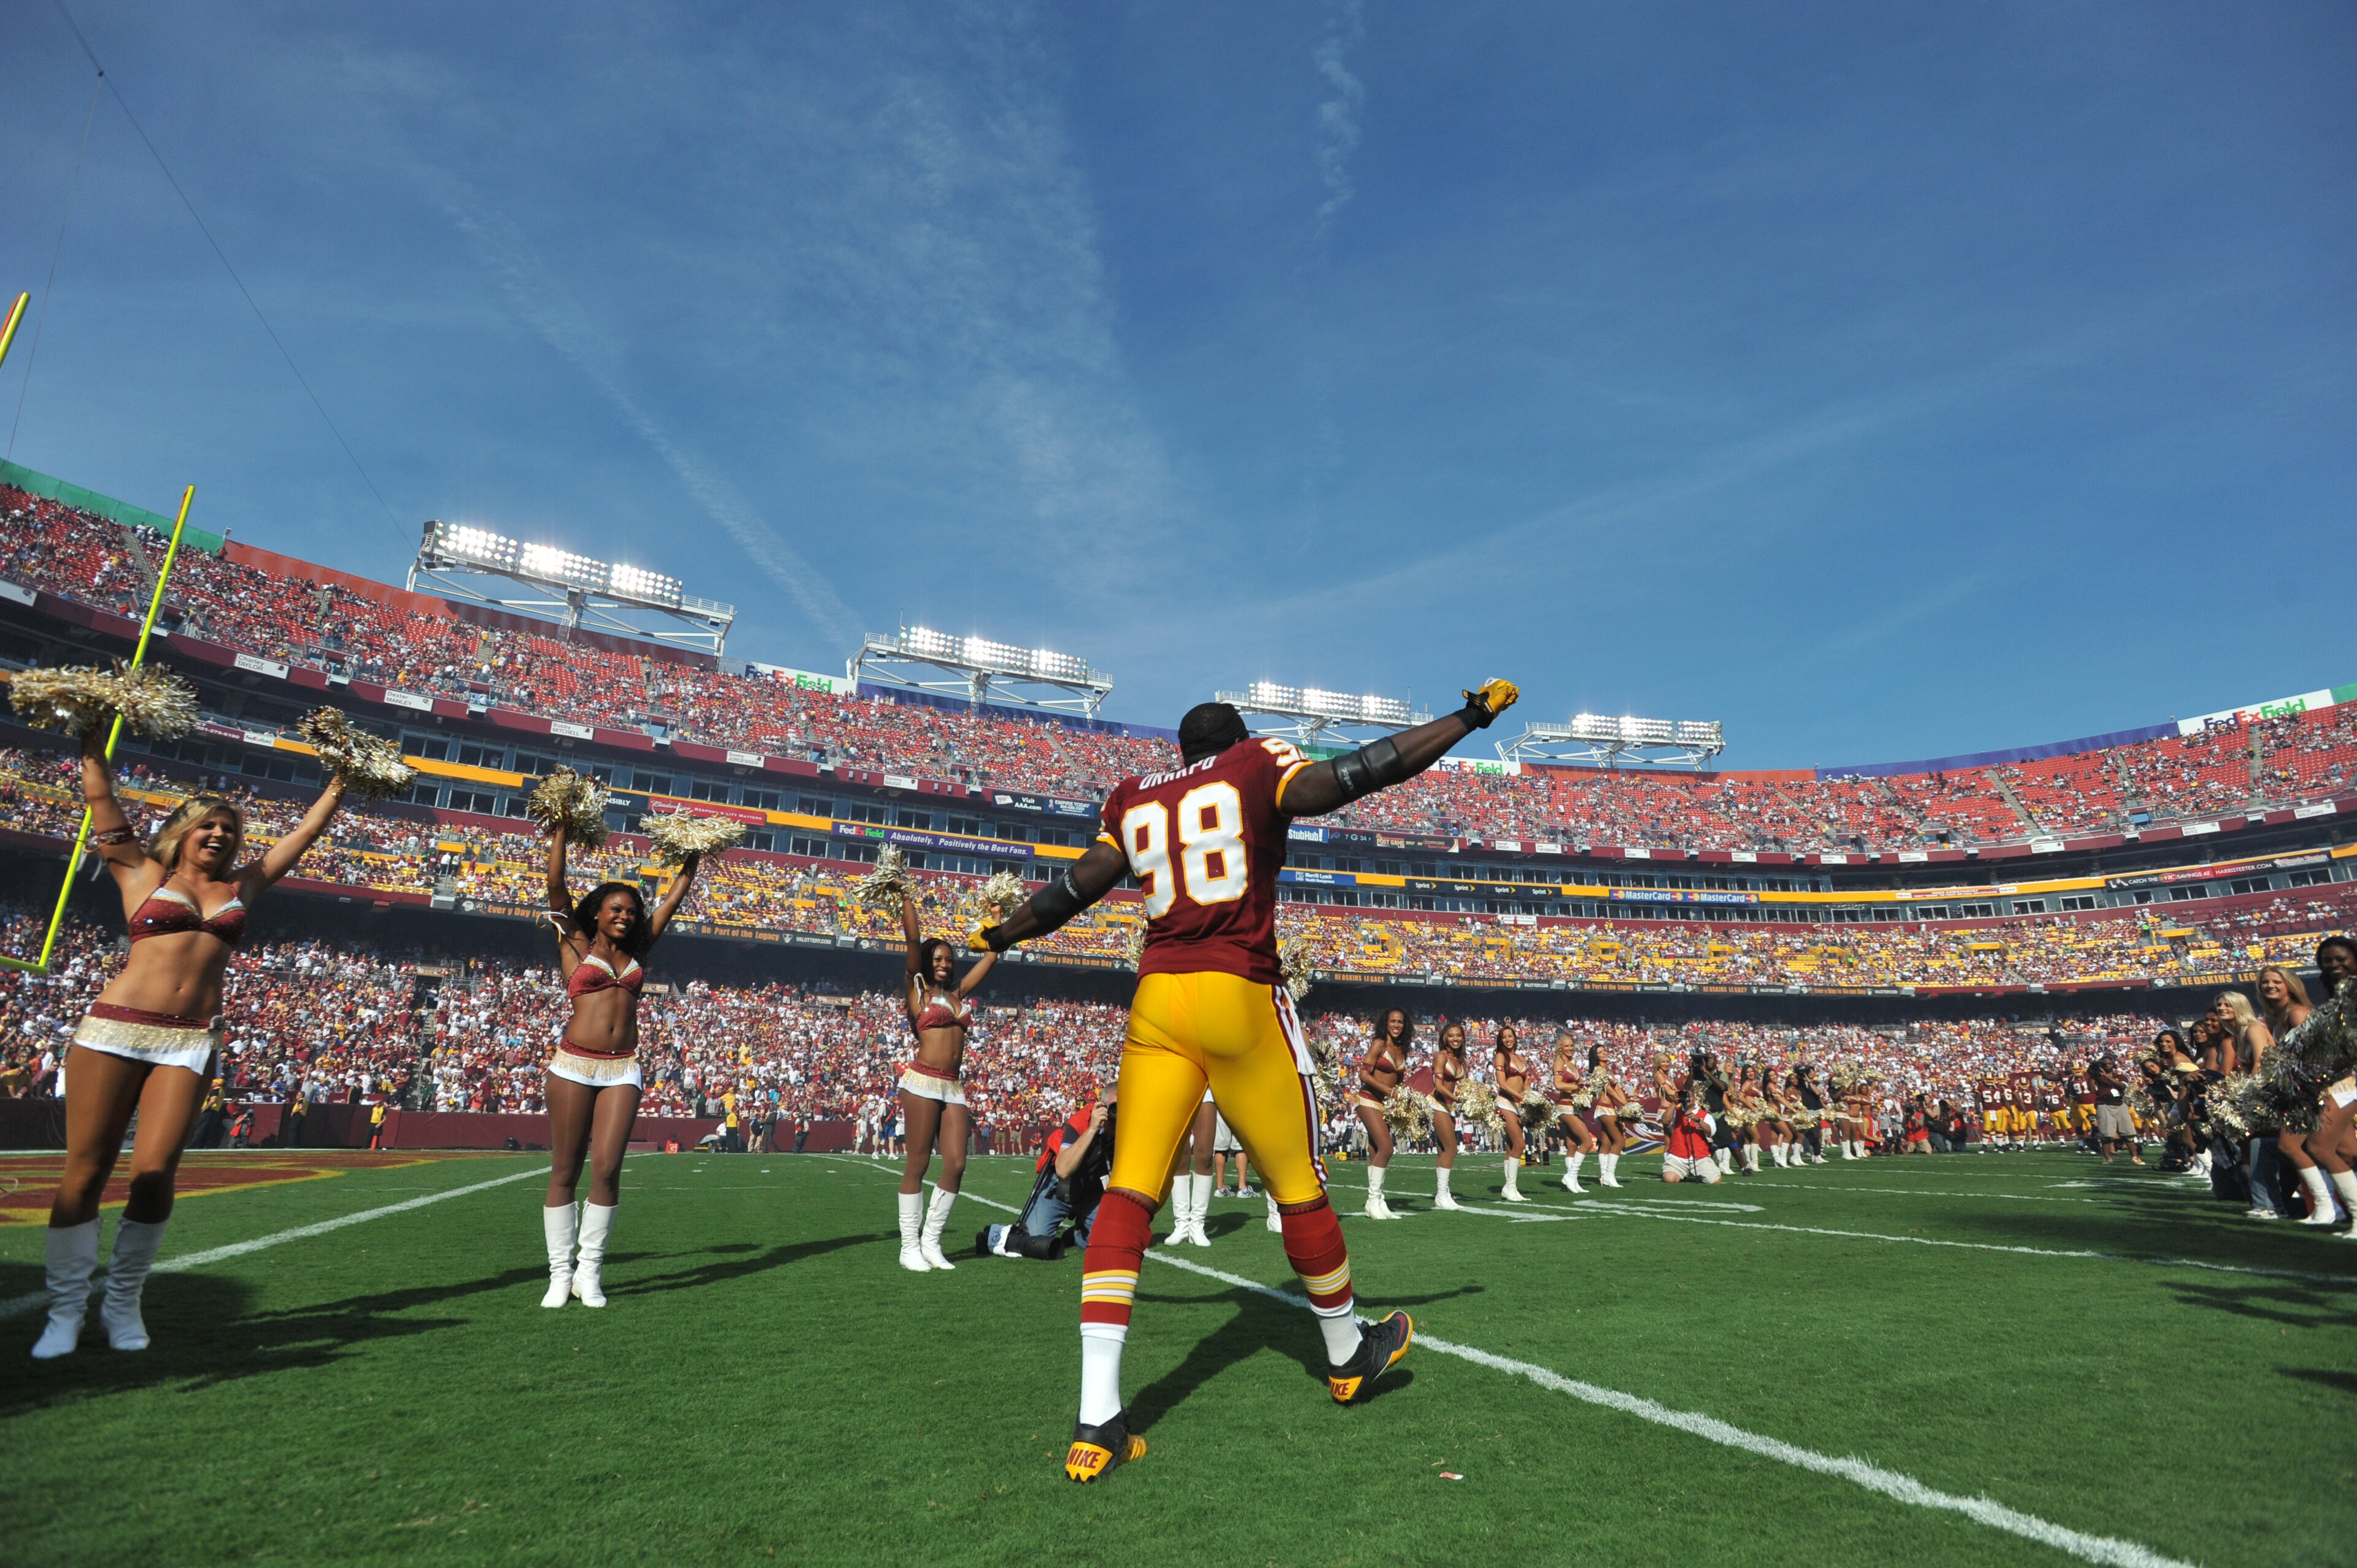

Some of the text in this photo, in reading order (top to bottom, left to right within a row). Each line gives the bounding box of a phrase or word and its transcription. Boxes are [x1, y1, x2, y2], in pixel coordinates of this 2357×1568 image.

[238, 655, 265, 665] Charley
[238, 660, 263, 671] TAYLOR
[386, 697, 412, 706] MANLEY
[552, 727, 579, 736] MITCHELL
[728, 756, 759, 765] JURGENSEN
[1014, 802, 1042, 811] AAA.com
[839, 824, 1028, 855] FedExField Absolutely, Positively the Best Fans.
[1288, 828, 1323, 841] StubHub!
[1121, 781, 1248, 920] 98
[2215, 862, 2272, 875] HARRISTEETER.COM
[1625, 891, 1670, 900] MasterCard
[1700, 894, 1745, 902] MasterCard
[514, 908, 530, 917] Day
[714, 927, 730, 936] Part
[731, 928, 739, 937] of
[741, 929, 753, 938] the
[755, 931, 780, 941] Legacy
[795, 936, 832, 944] VALOTTERY.COM
[1101, 959, 1112, 968] Day
[1364, 975, 1384, 983] LEGACY
[2181, 973, 2258, 986] REDSKINS LEG
[1982, 1091, 2001, 1103] 54
[1329, 1381, 1350, 1396] IKE
[1066, 1447, 1102, 1469] NIKE
